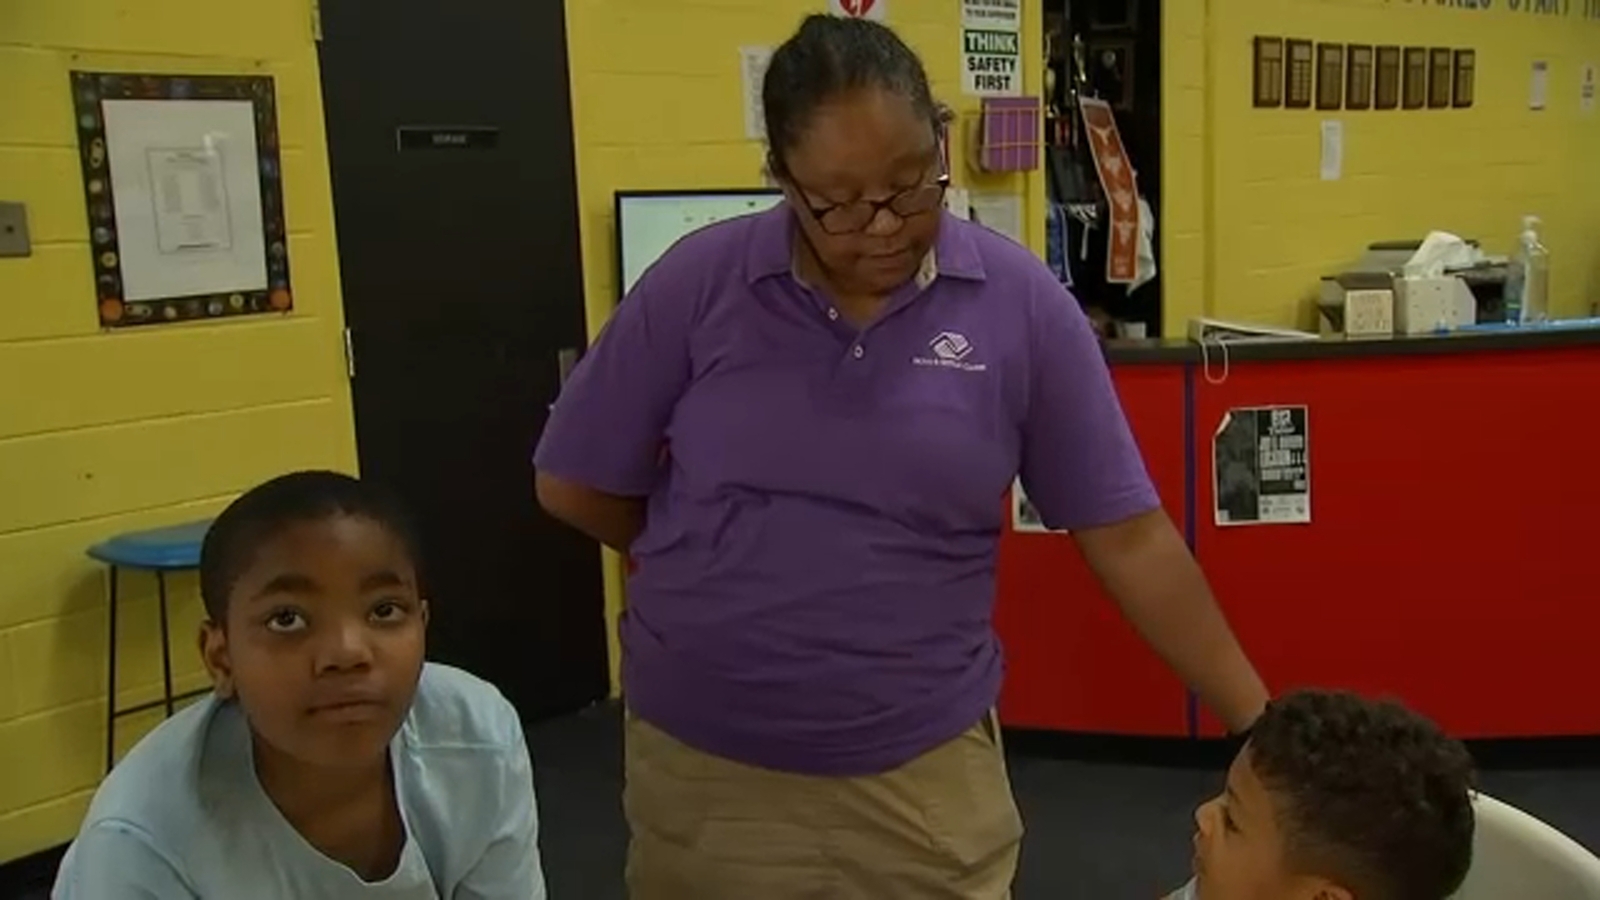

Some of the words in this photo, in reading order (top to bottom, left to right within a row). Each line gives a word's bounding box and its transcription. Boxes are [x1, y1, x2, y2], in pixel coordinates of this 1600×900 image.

[967, 31, 1017, 53] THINK
[967, 56, 1016, 73] SAFETY
[974, 74, 1011, 91] FIRST
